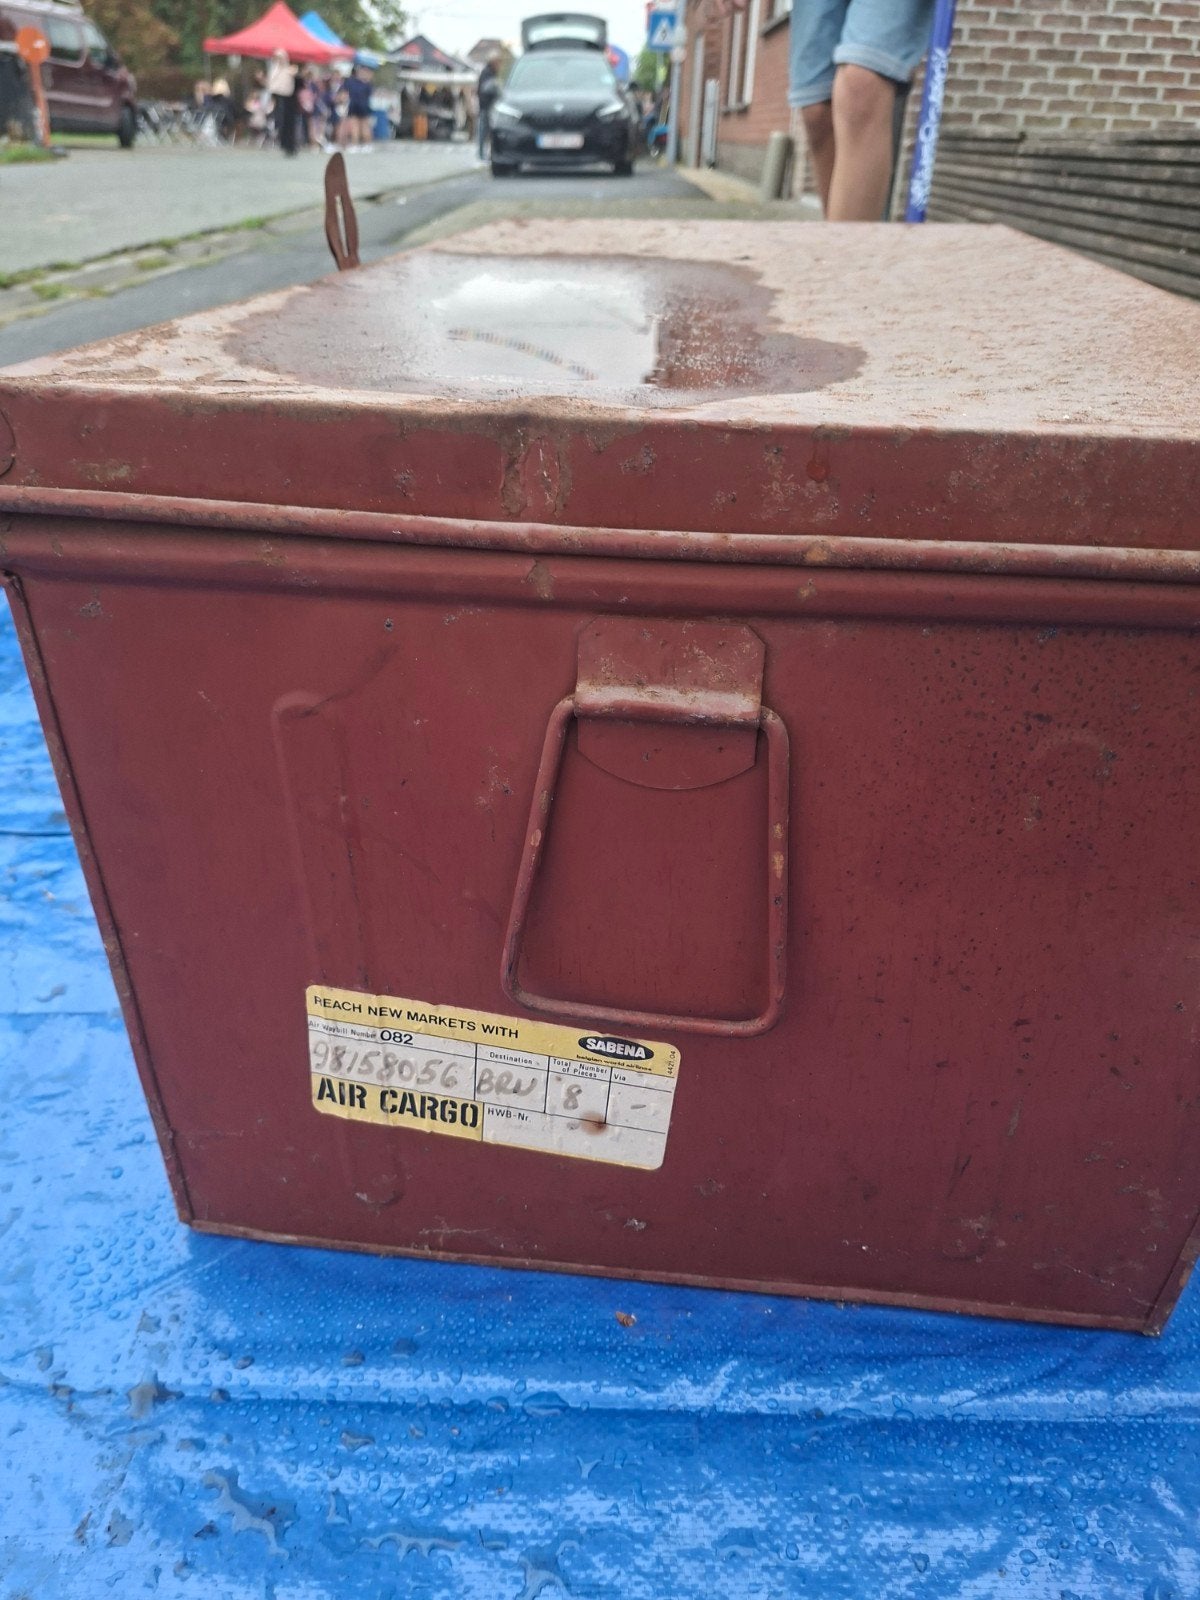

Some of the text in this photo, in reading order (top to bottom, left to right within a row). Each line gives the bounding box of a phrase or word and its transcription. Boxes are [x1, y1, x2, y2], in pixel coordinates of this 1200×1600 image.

[314, 995, 519, 1038] REACH NEW MARKETS WITH
[380, 1029, 414, 1046] 082
[585, 1037, 646, 1059] SABENA
[489, 1051, 533, 1065] Destination
[553, 1058, 608, 1074] Total Number
[561, 1066, 598, 1078] of Pieces
[613, 1073, 626, 1082] Via
[317, 1077, 479, 1128] AIR CARGO
[563, 1083, 583, 1110] 8
